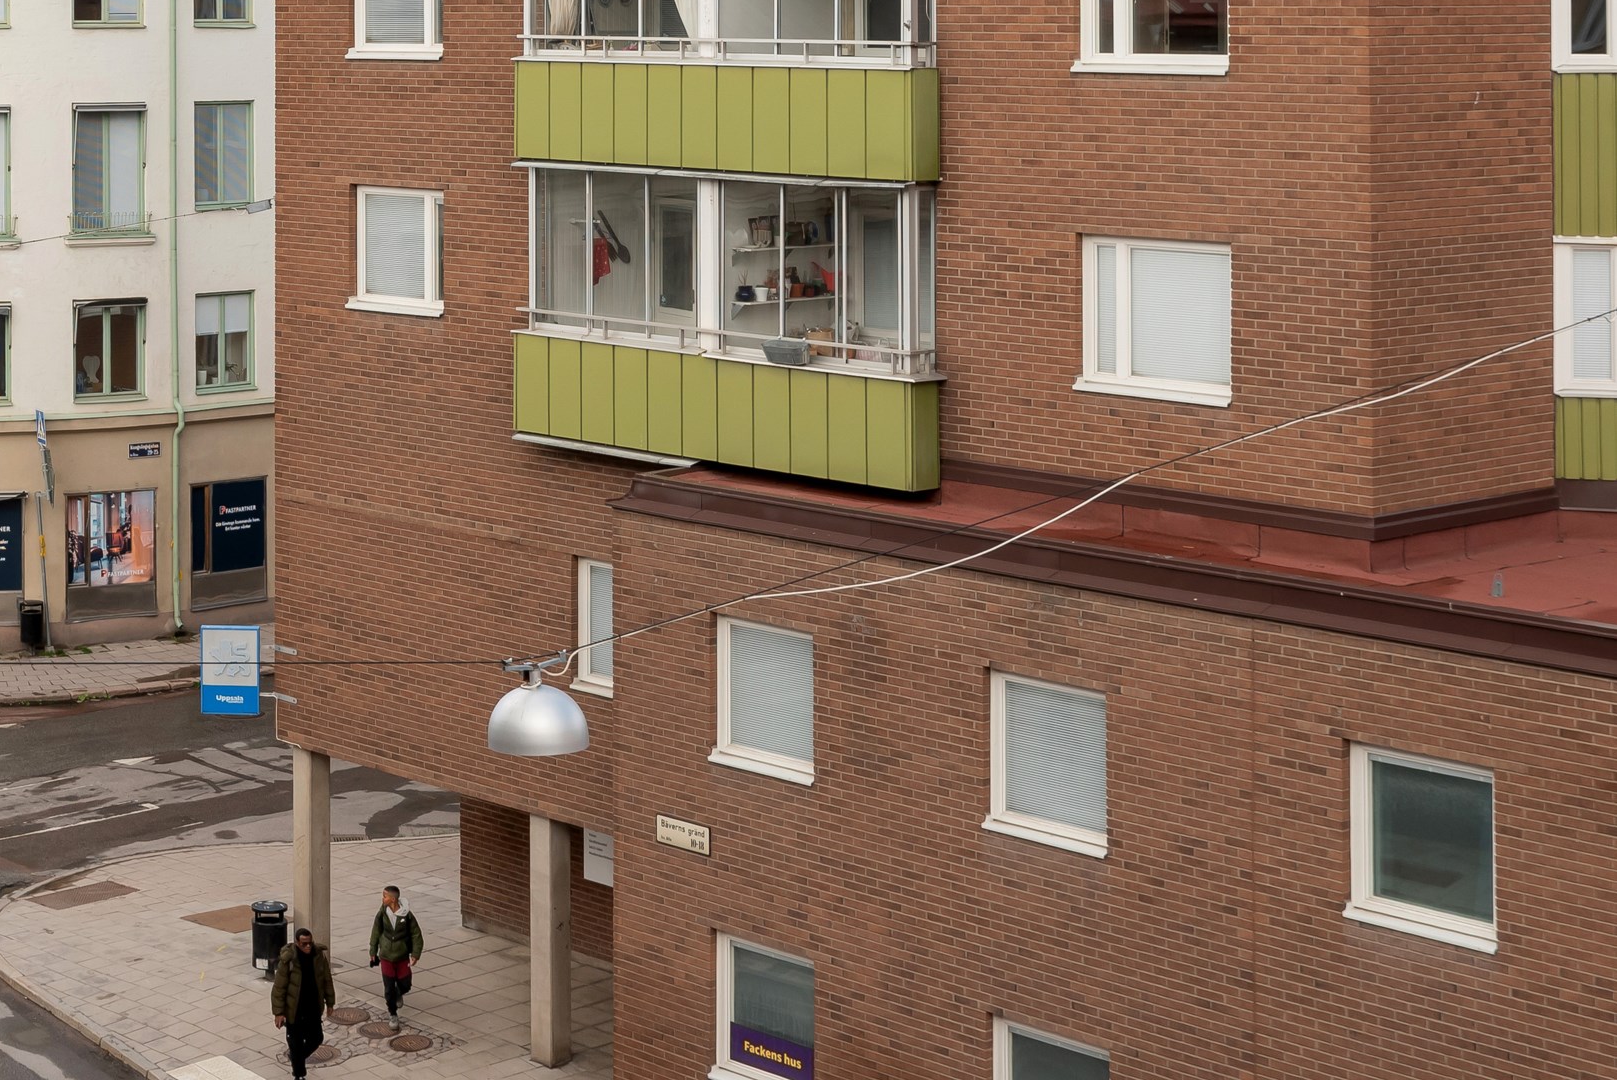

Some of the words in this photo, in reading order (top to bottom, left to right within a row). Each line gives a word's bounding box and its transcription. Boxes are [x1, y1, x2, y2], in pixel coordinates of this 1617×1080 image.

[225, 504, 257, 514] FASTPARTNER
[107, 569, 144, 578] FASTPARTNER
[215, 694, 244, 702] Uppsala
[660, 819, 686, 833] Bäverns
[687, 828, 705, 839] gränd
[690, 838, 705, 851] 10-18
[744, 1040, 782, 1063] Fackens
[784, 1053, 802, 1070] hus
